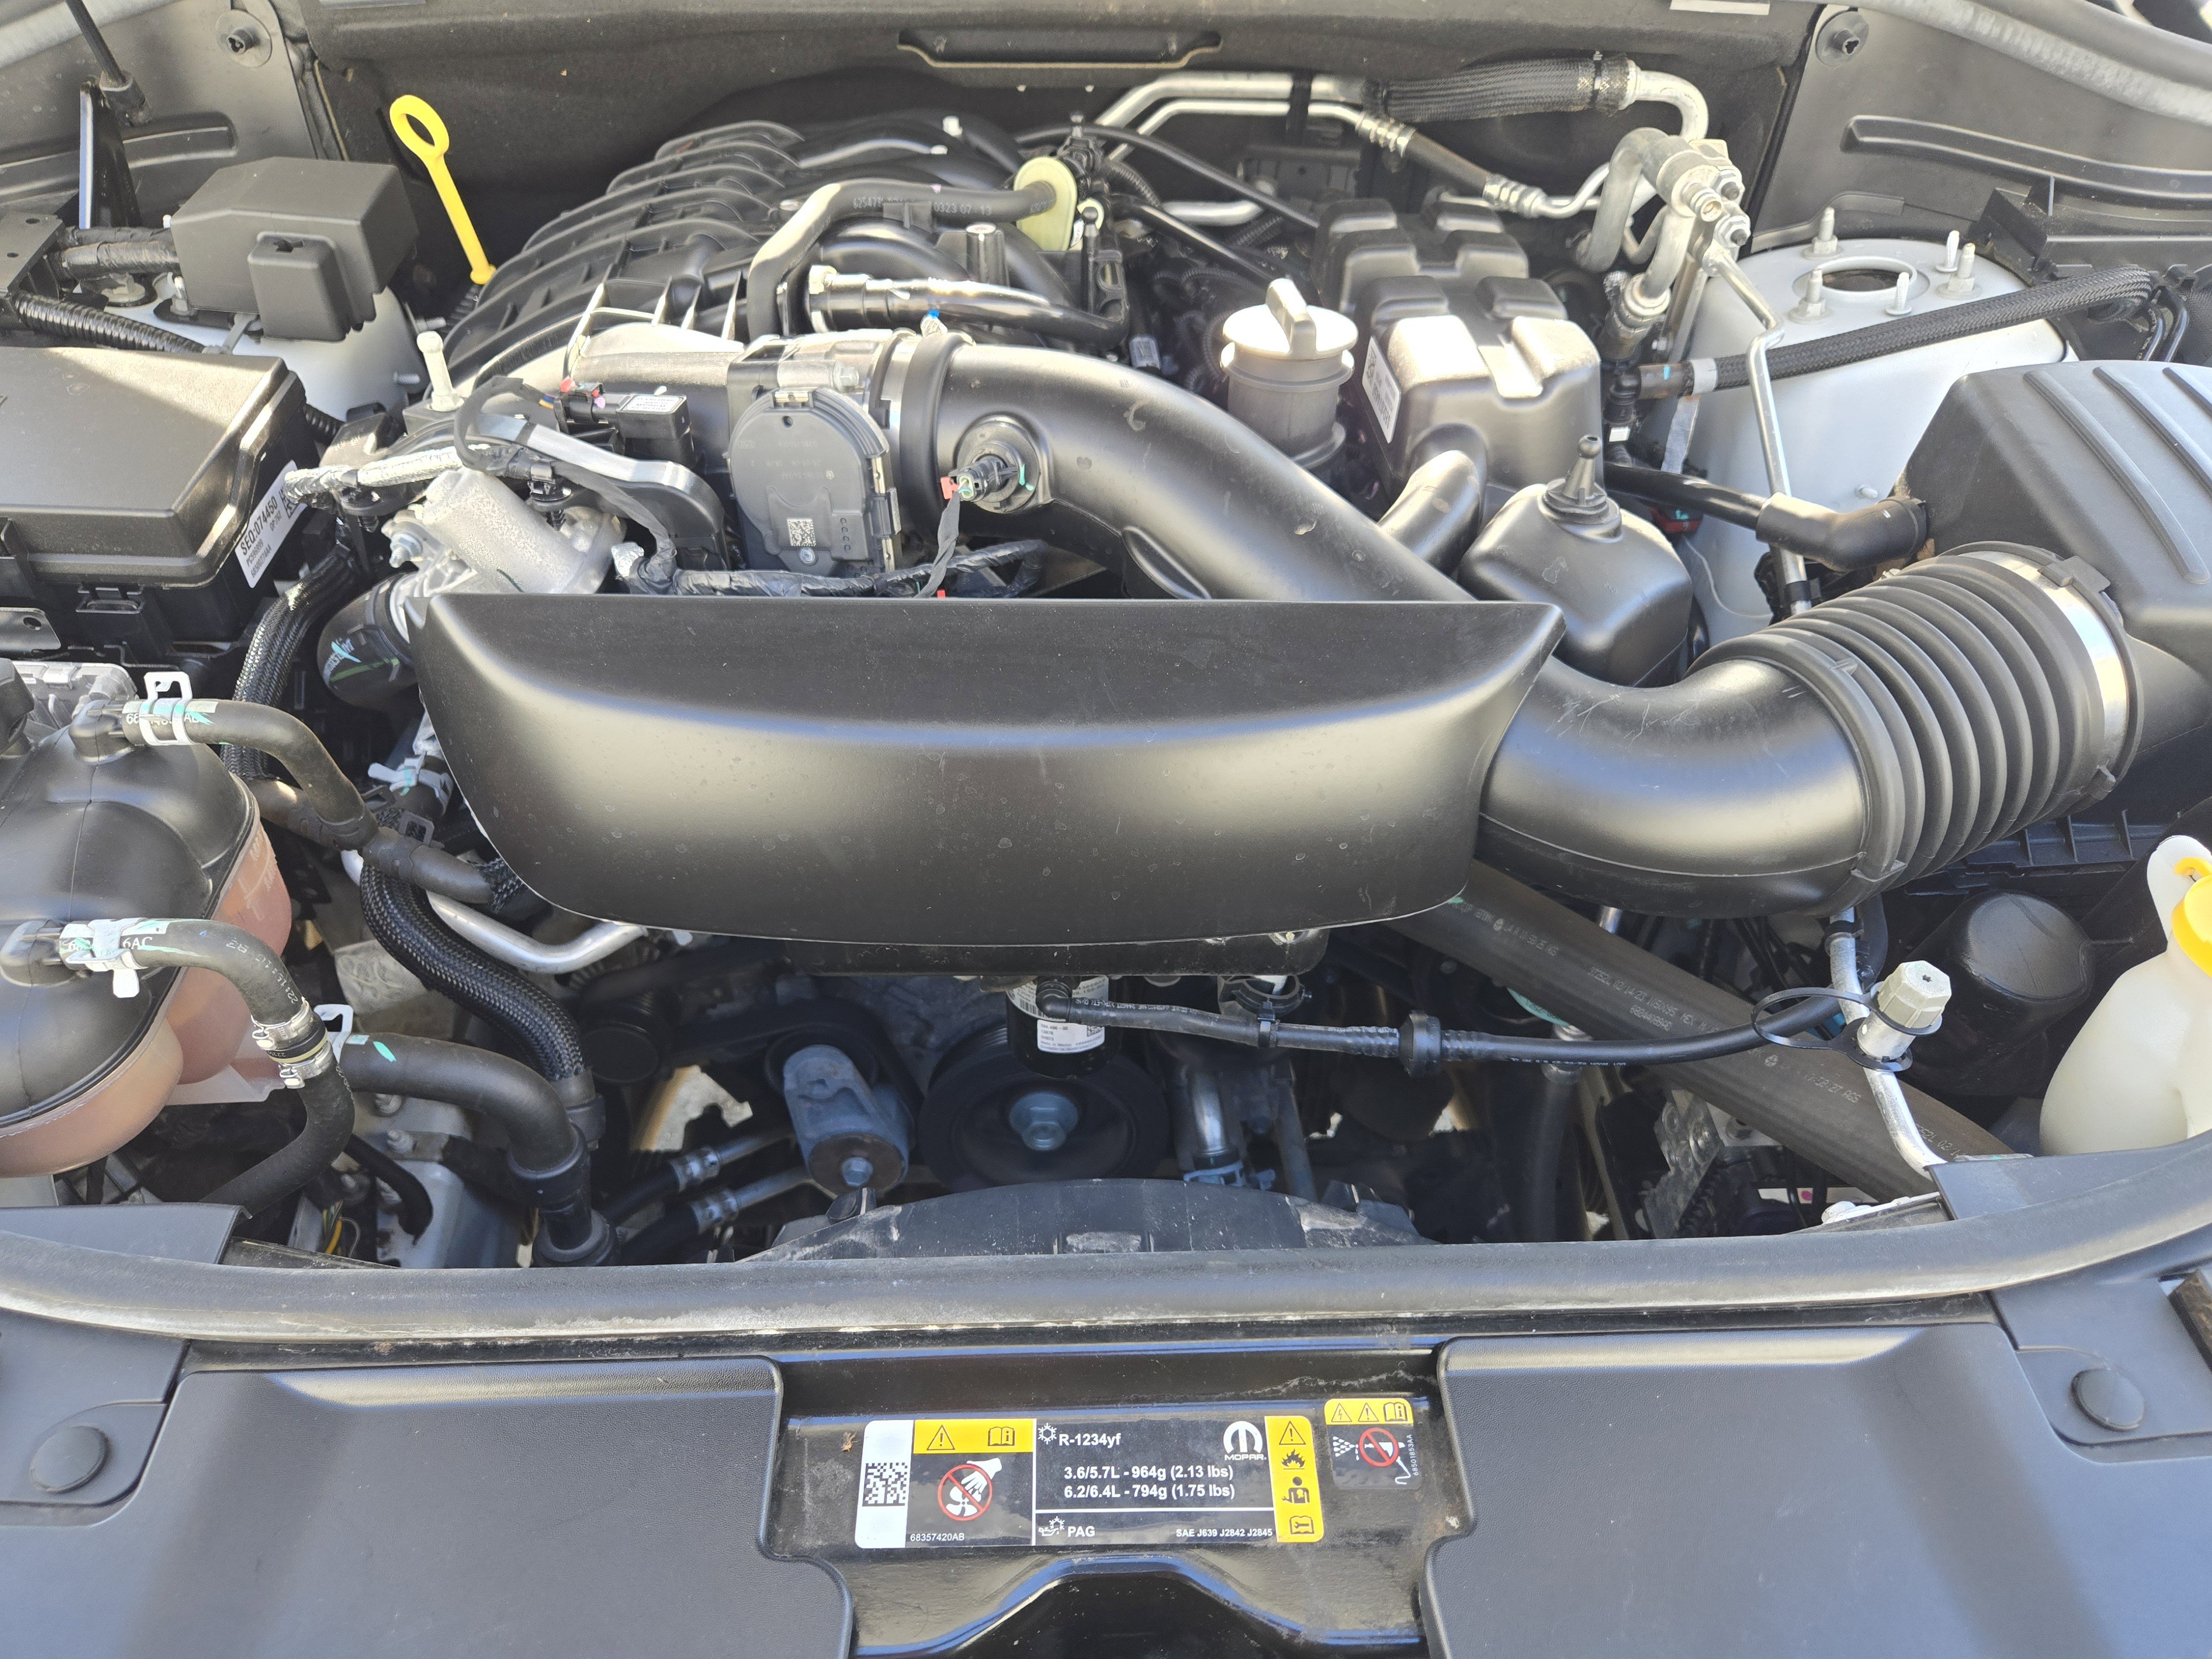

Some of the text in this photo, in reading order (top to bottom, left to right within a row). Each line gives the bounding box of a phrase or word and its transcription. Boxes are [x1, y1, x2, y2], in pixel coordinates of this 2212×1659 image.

[241, 496, 278, 555] SEQ:074450
[1059, 1433, 1121, 1448] R-1234yf
[1406, 1434, 1418, 1475] 68501853AA
[1064, 1466, 1120, 1479] 3.6/5.7L
[1131, 1465, 1166, 1481] 964g
[1171, 1465, 1204, 1481] (2.13
[1207, 1464, 1234, 1480] lbs)
[1064, 1485, 1120, 1498] 6.2/6.4L
[1132, 1485, 1167, 1499] 794g
[1172, 1484, 1205, 1499] (1.75
[1209, 1484, 1235, 1499] lbs)
[910, 1532, 965, 1542] 68357420AB
[1068, 1526, 1095, 1537] PAG
[1176, 1528, 1273, 1537] SAE J639 J2842 J2845
